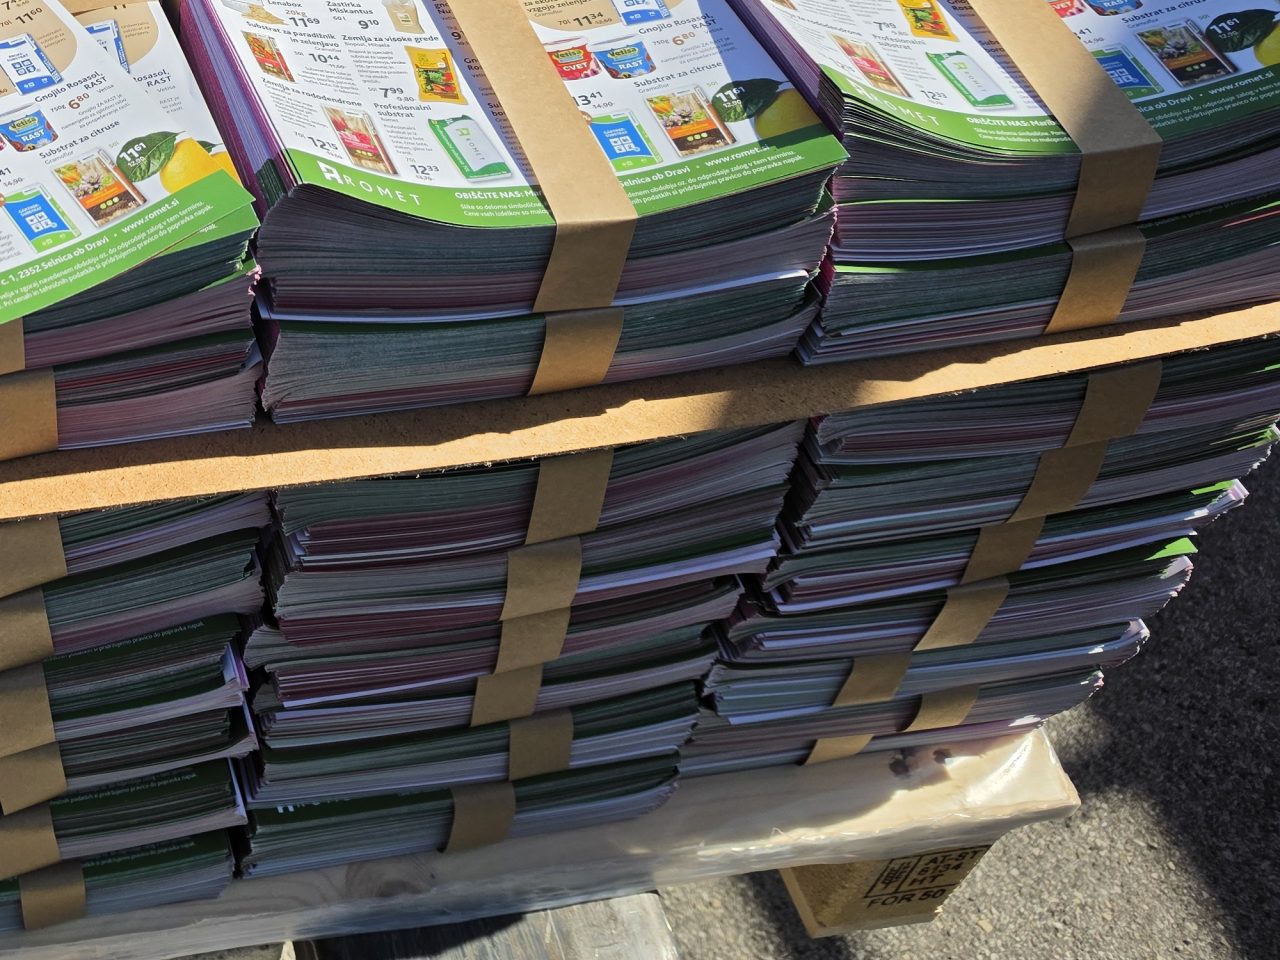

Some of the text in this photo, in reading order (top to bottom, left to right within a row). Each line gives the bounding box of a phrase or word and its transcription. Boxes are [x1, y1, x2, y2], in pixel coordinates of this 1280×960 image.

[1122, 8, 1163, 24] Substrat
[617, 59, 644, 70] RAST
[689, 61, 722, 76] citruse
[34, 72, 104, 103] Gnojilo Rosasol,
[147, 75, 171, 88] RAST
[20, 129, 45, 142] RAST
[343, 172, 420, 206] ROMET
[18, 264, 43, 281] 2352
[41, 251, 74, 272] Selnica
[86, 236, 109, 254] Dravi
[121, 199, 180, 235] www.romet.si
[908, 873, 945, 887] HT
[866, 893, 915, 908] FOR
